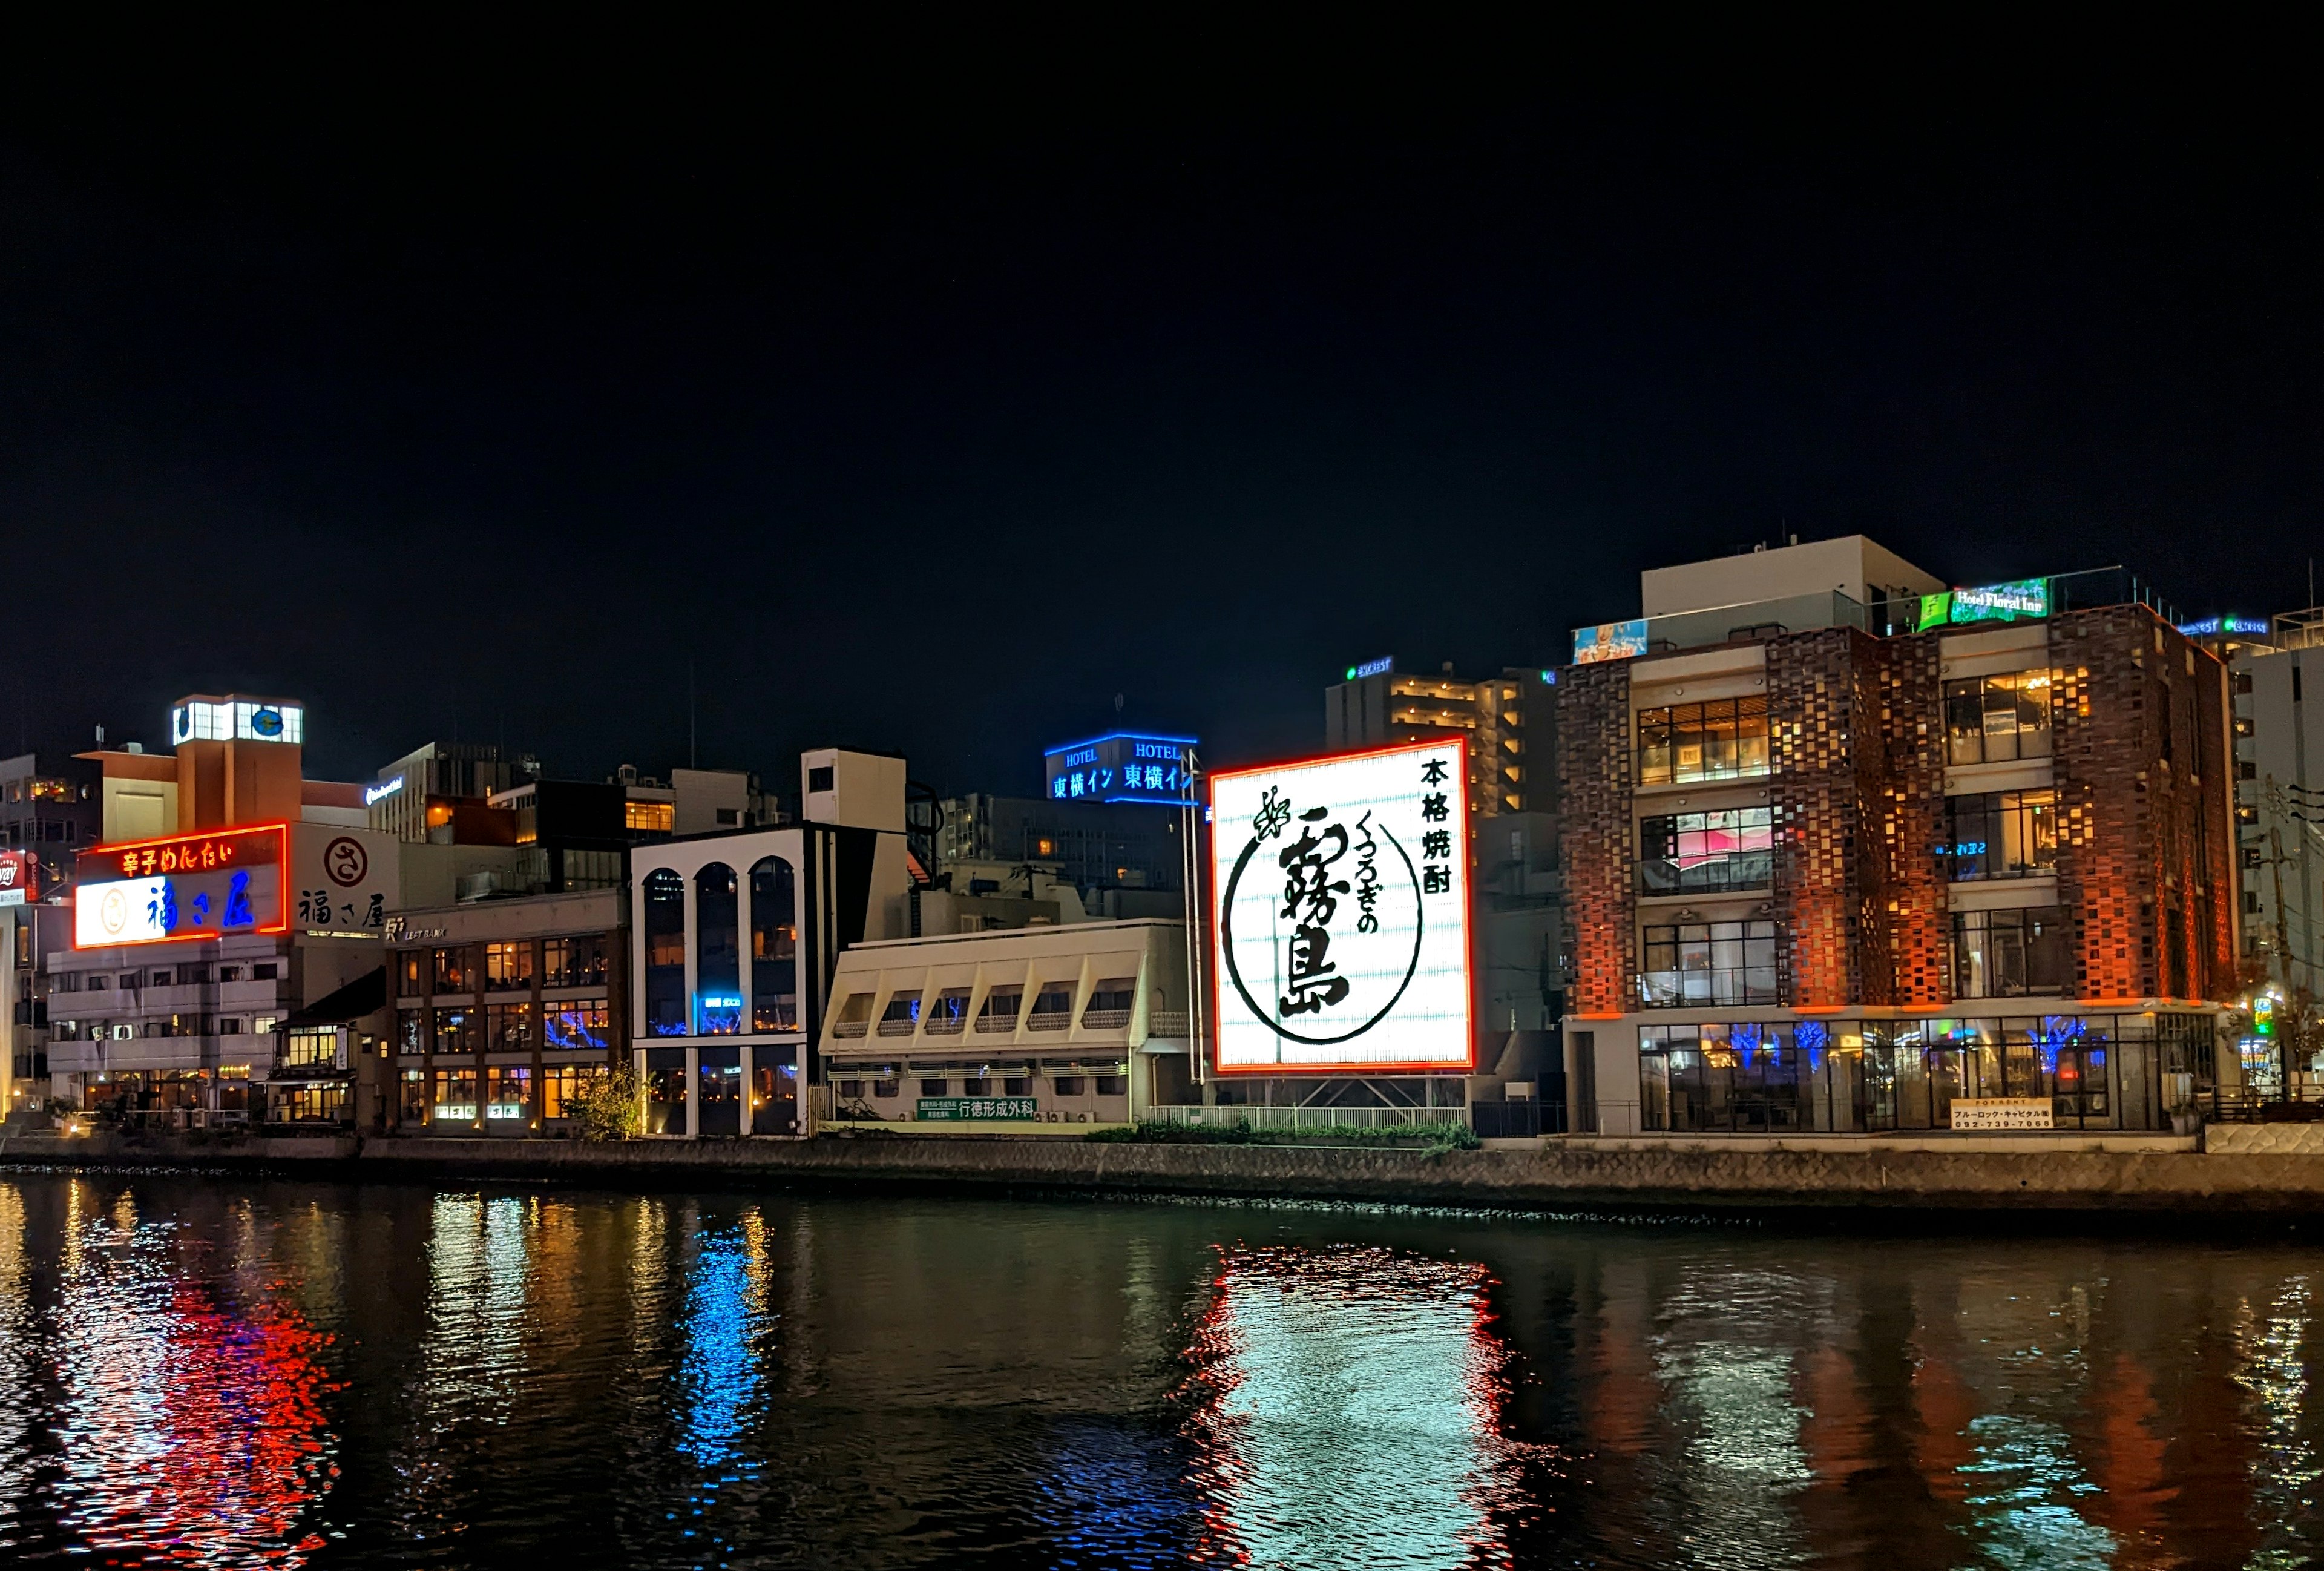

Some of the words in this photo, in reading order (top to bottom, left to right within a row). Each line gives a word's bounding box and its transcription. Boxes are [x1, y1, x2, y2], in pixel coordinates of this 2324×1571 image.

[1958, 591, 1983, 605] Hotel
[1986, 593, 2020, 610] Floral
[2022, 596, 2042, 611] Inn
[1066, 749, 1097, 767] HOTEL
[1135, 743, 1181, 760] HOTEL
[1054, 767, 1112, 798] 東横イン
[1422, 759, 1451, 894] 本格焼酎
[123, 842, 232, 877] 辛子めんたい
[335, 845, 358, 880] さ
[1354, 809, 1383, 933] くつろぎの
[147, 872, 254, 930] 福さ屋
[299, 890, 385, 927] 福さ屋
[1279, 806, 1350, 1018] 霧島
[405, 930, 423, 940] LEFT
[424, 929, 447, 938] BANK
[959, 1101, 1034, 1118] 行徳形成外科
